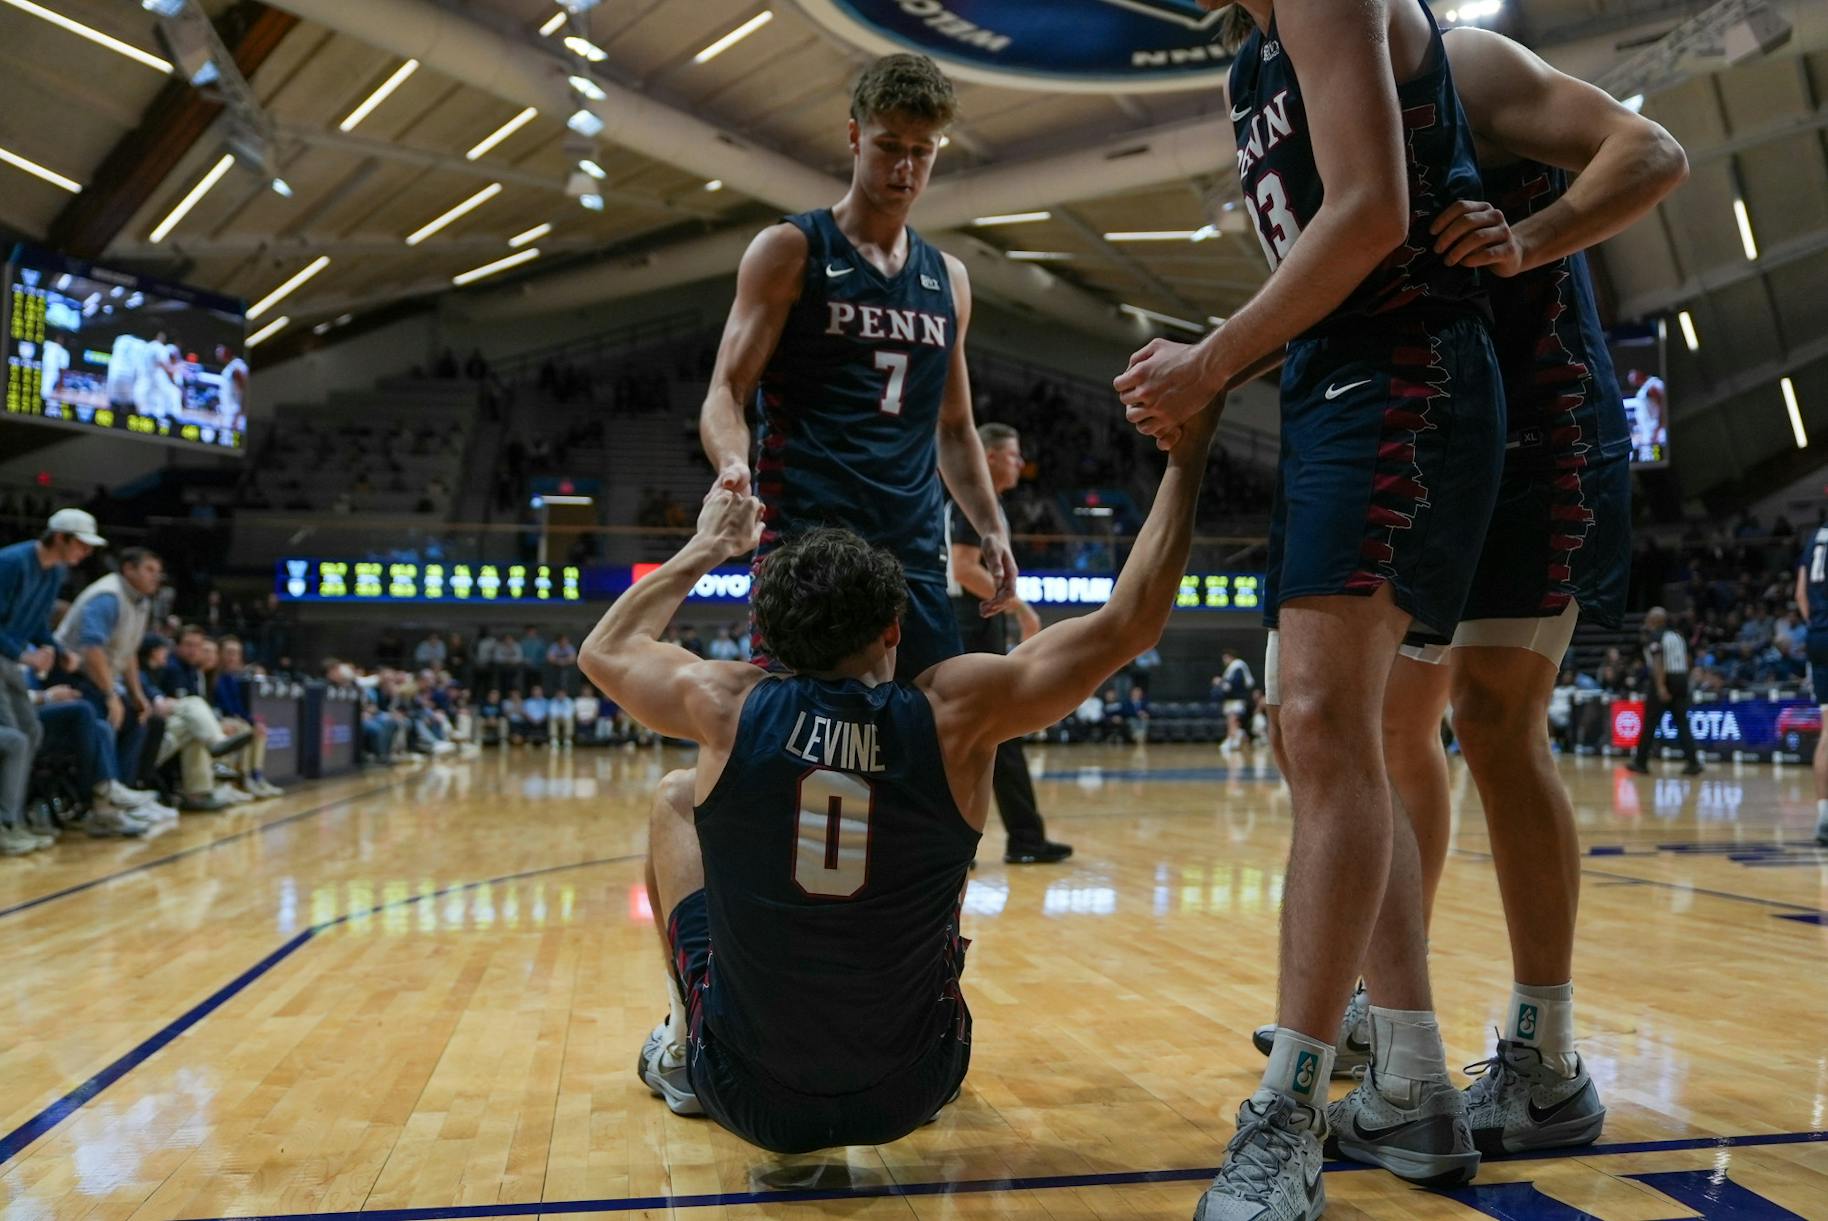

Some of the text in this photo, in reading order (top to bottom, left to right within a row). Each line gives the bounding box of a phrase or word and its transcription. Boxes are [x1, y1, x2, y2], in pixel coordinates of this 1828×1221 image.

[825, 302, 947, 348] PENN
[874, 350, 909, 415] 7
[1523, 432, 1538, 442] XL
[785, 711, 886, 772] LEVINE
[793, 766, 873, 898] 0
